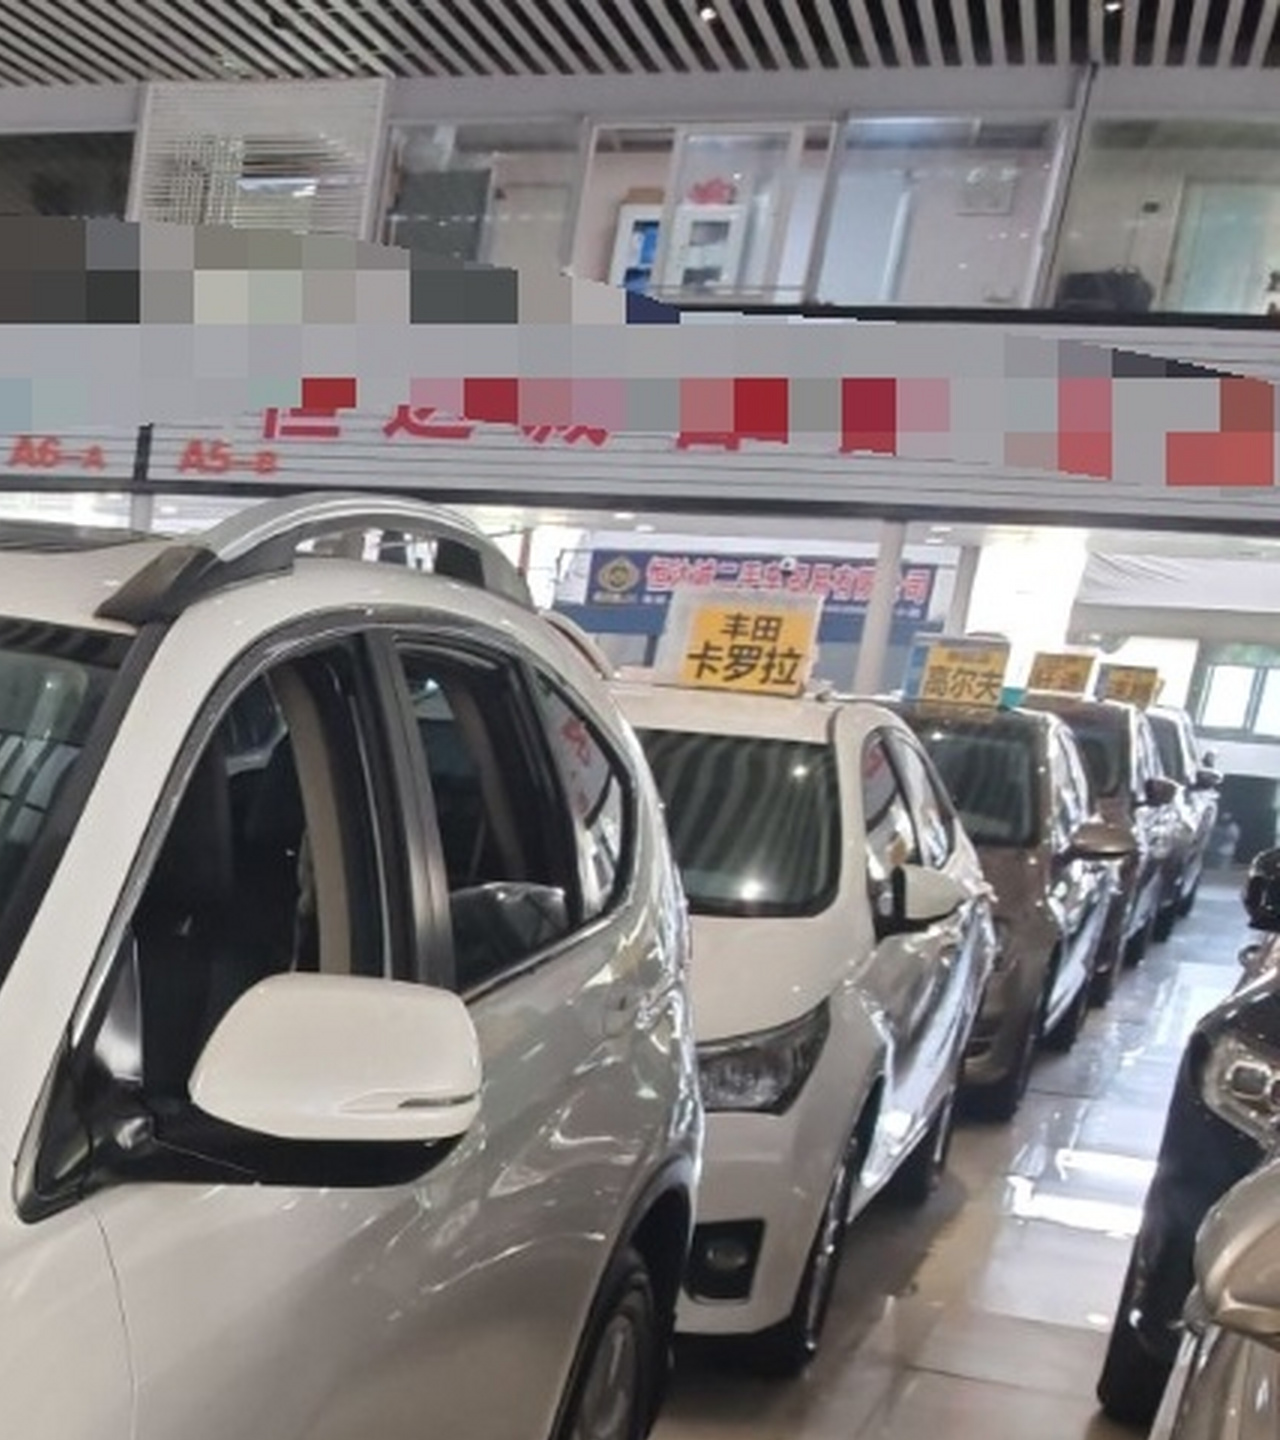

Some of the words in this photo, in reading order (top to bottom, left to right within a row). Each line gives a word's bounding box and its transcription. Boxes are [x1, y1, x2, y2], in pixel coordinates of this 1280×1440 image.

[720, 612, 782, 642] 丰田
[686, 639, 803, 684] 卡罗拉
[924, 666, 1002, 699] 高尔夫
